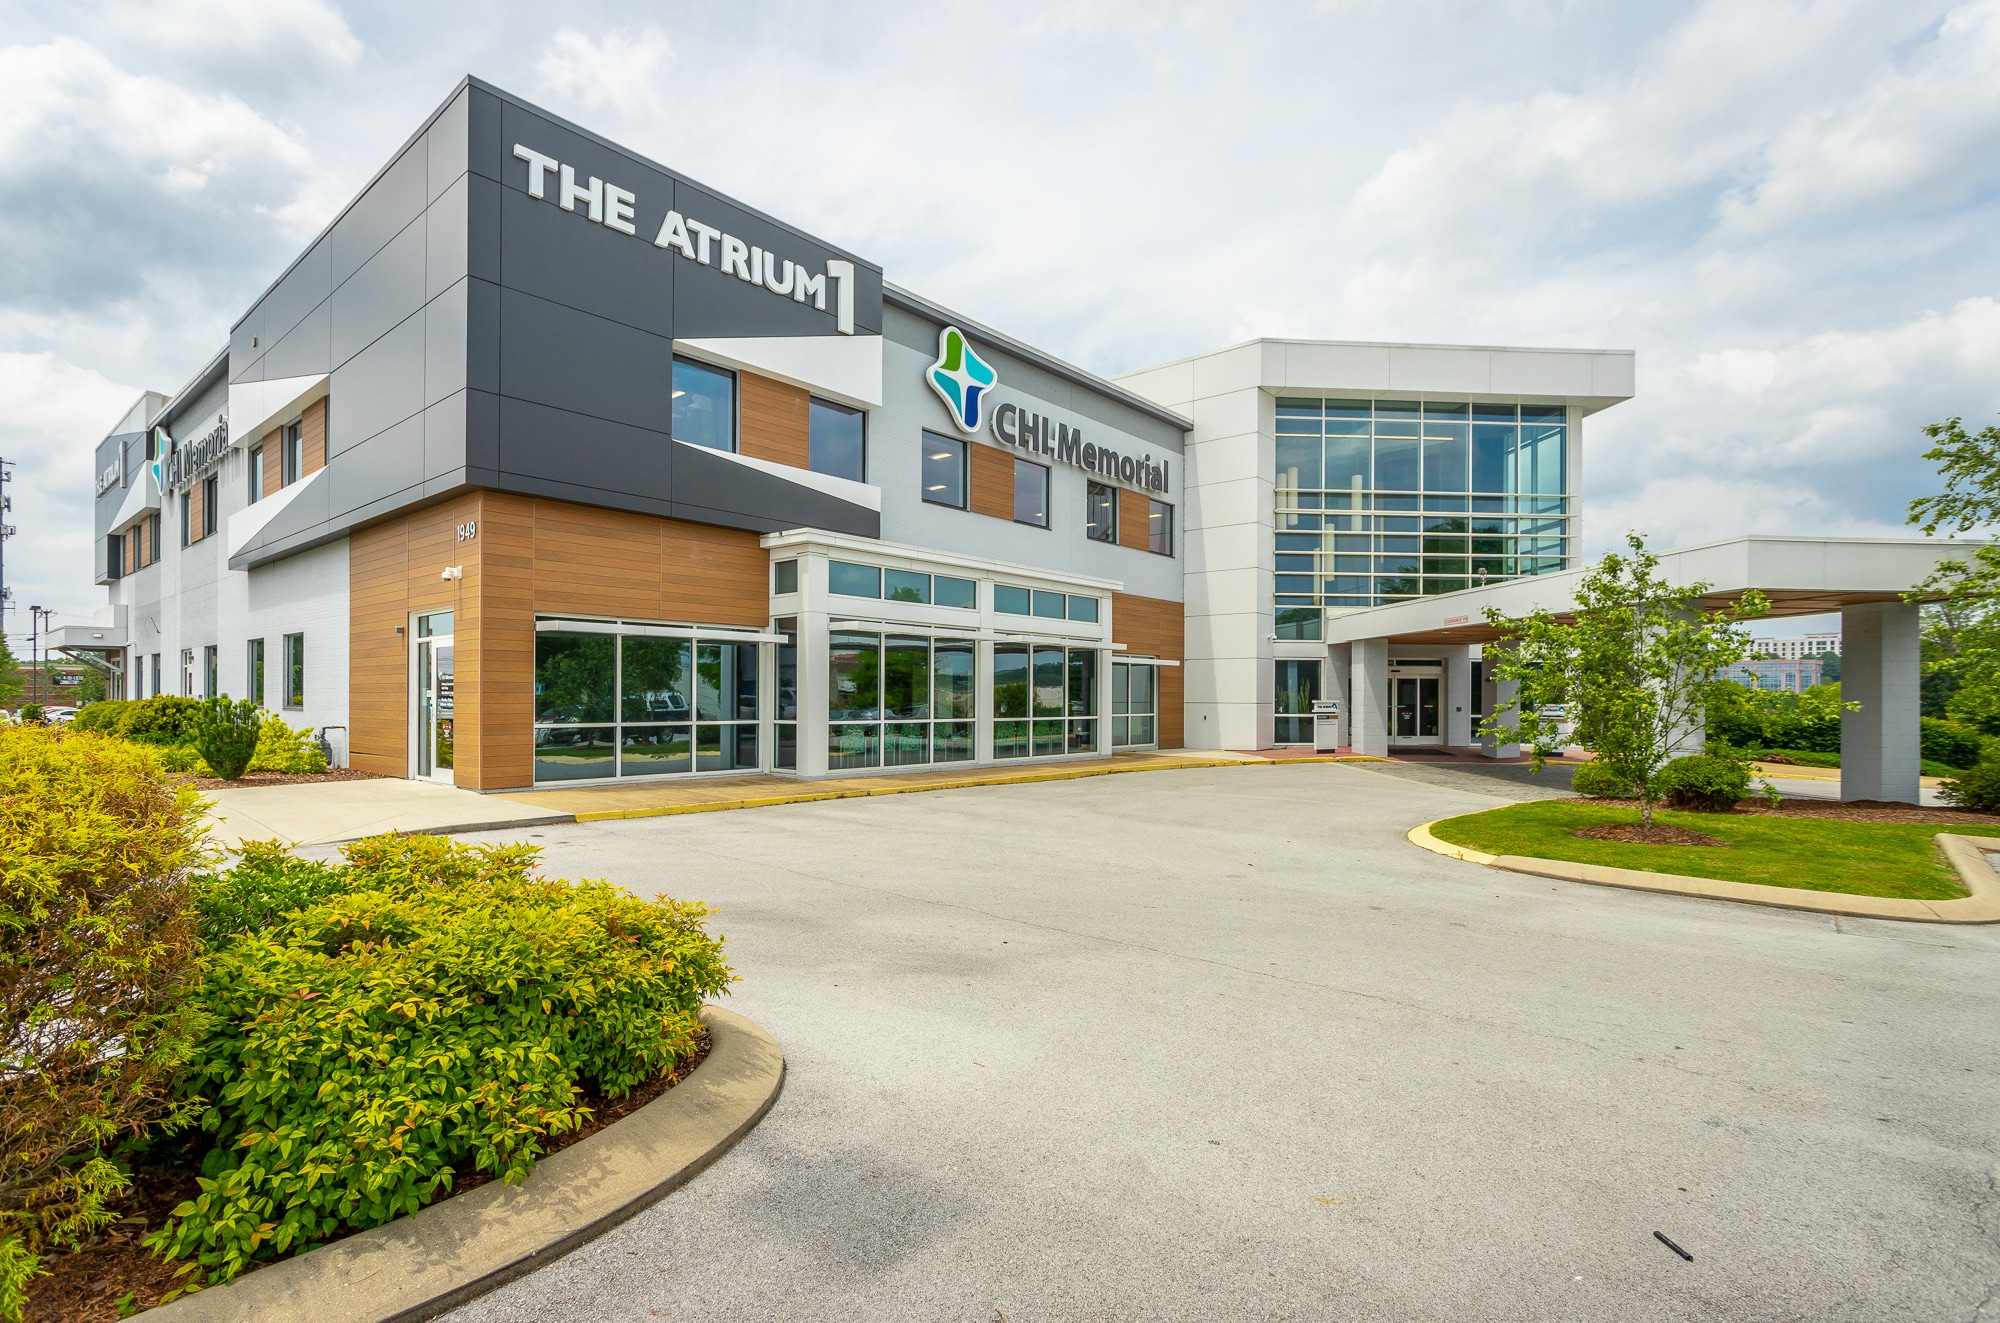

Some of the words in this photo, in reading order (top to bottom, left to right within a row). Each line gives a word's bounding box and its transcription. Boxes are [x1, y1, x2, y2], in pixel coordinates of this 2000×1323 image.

[513, 143, 636, 236] THE
[183, 414, 229, 479] Memoria
[991, 402, 1049, 456] CHI
[1054, 422, 1169, 494] Memorial
[456, 520, 476, 542] 1949
